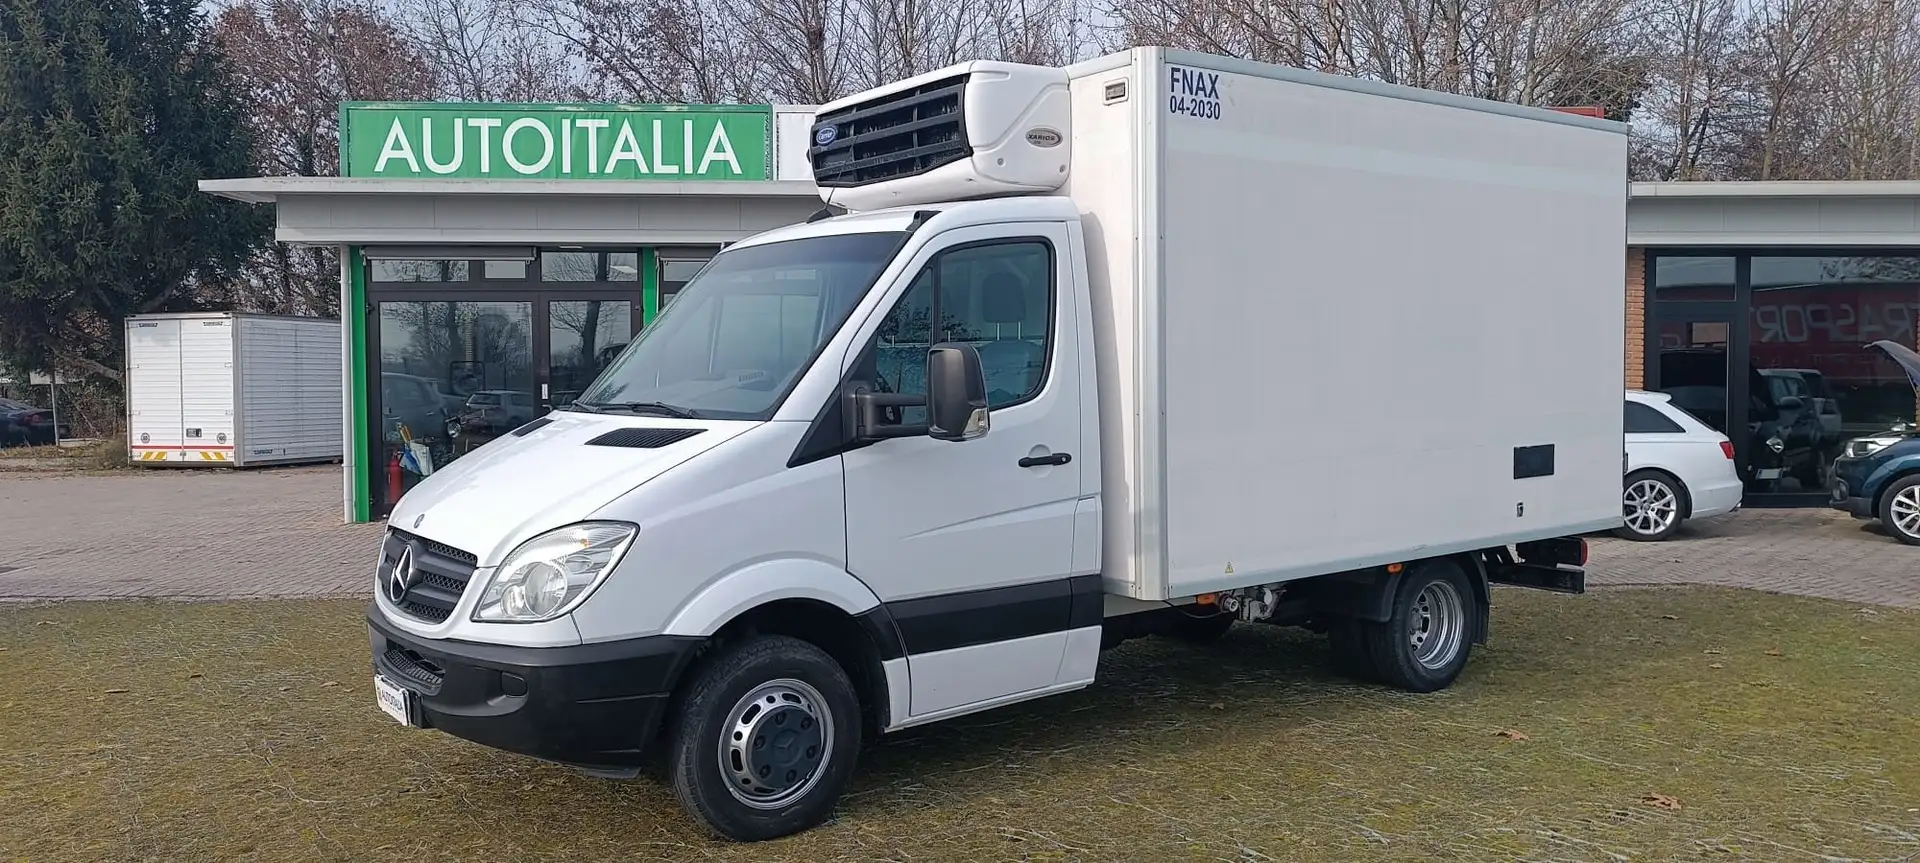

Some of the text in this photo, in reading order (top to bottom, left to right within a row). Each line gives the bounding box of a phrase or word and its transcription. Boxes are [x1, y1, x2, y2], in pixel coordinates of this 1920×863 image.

[1171, 67, 1219, 100] FNAX
[1170, 95, 1220, 119] 04-2030
[374, 115, 742, 175] AUTOITALIA
